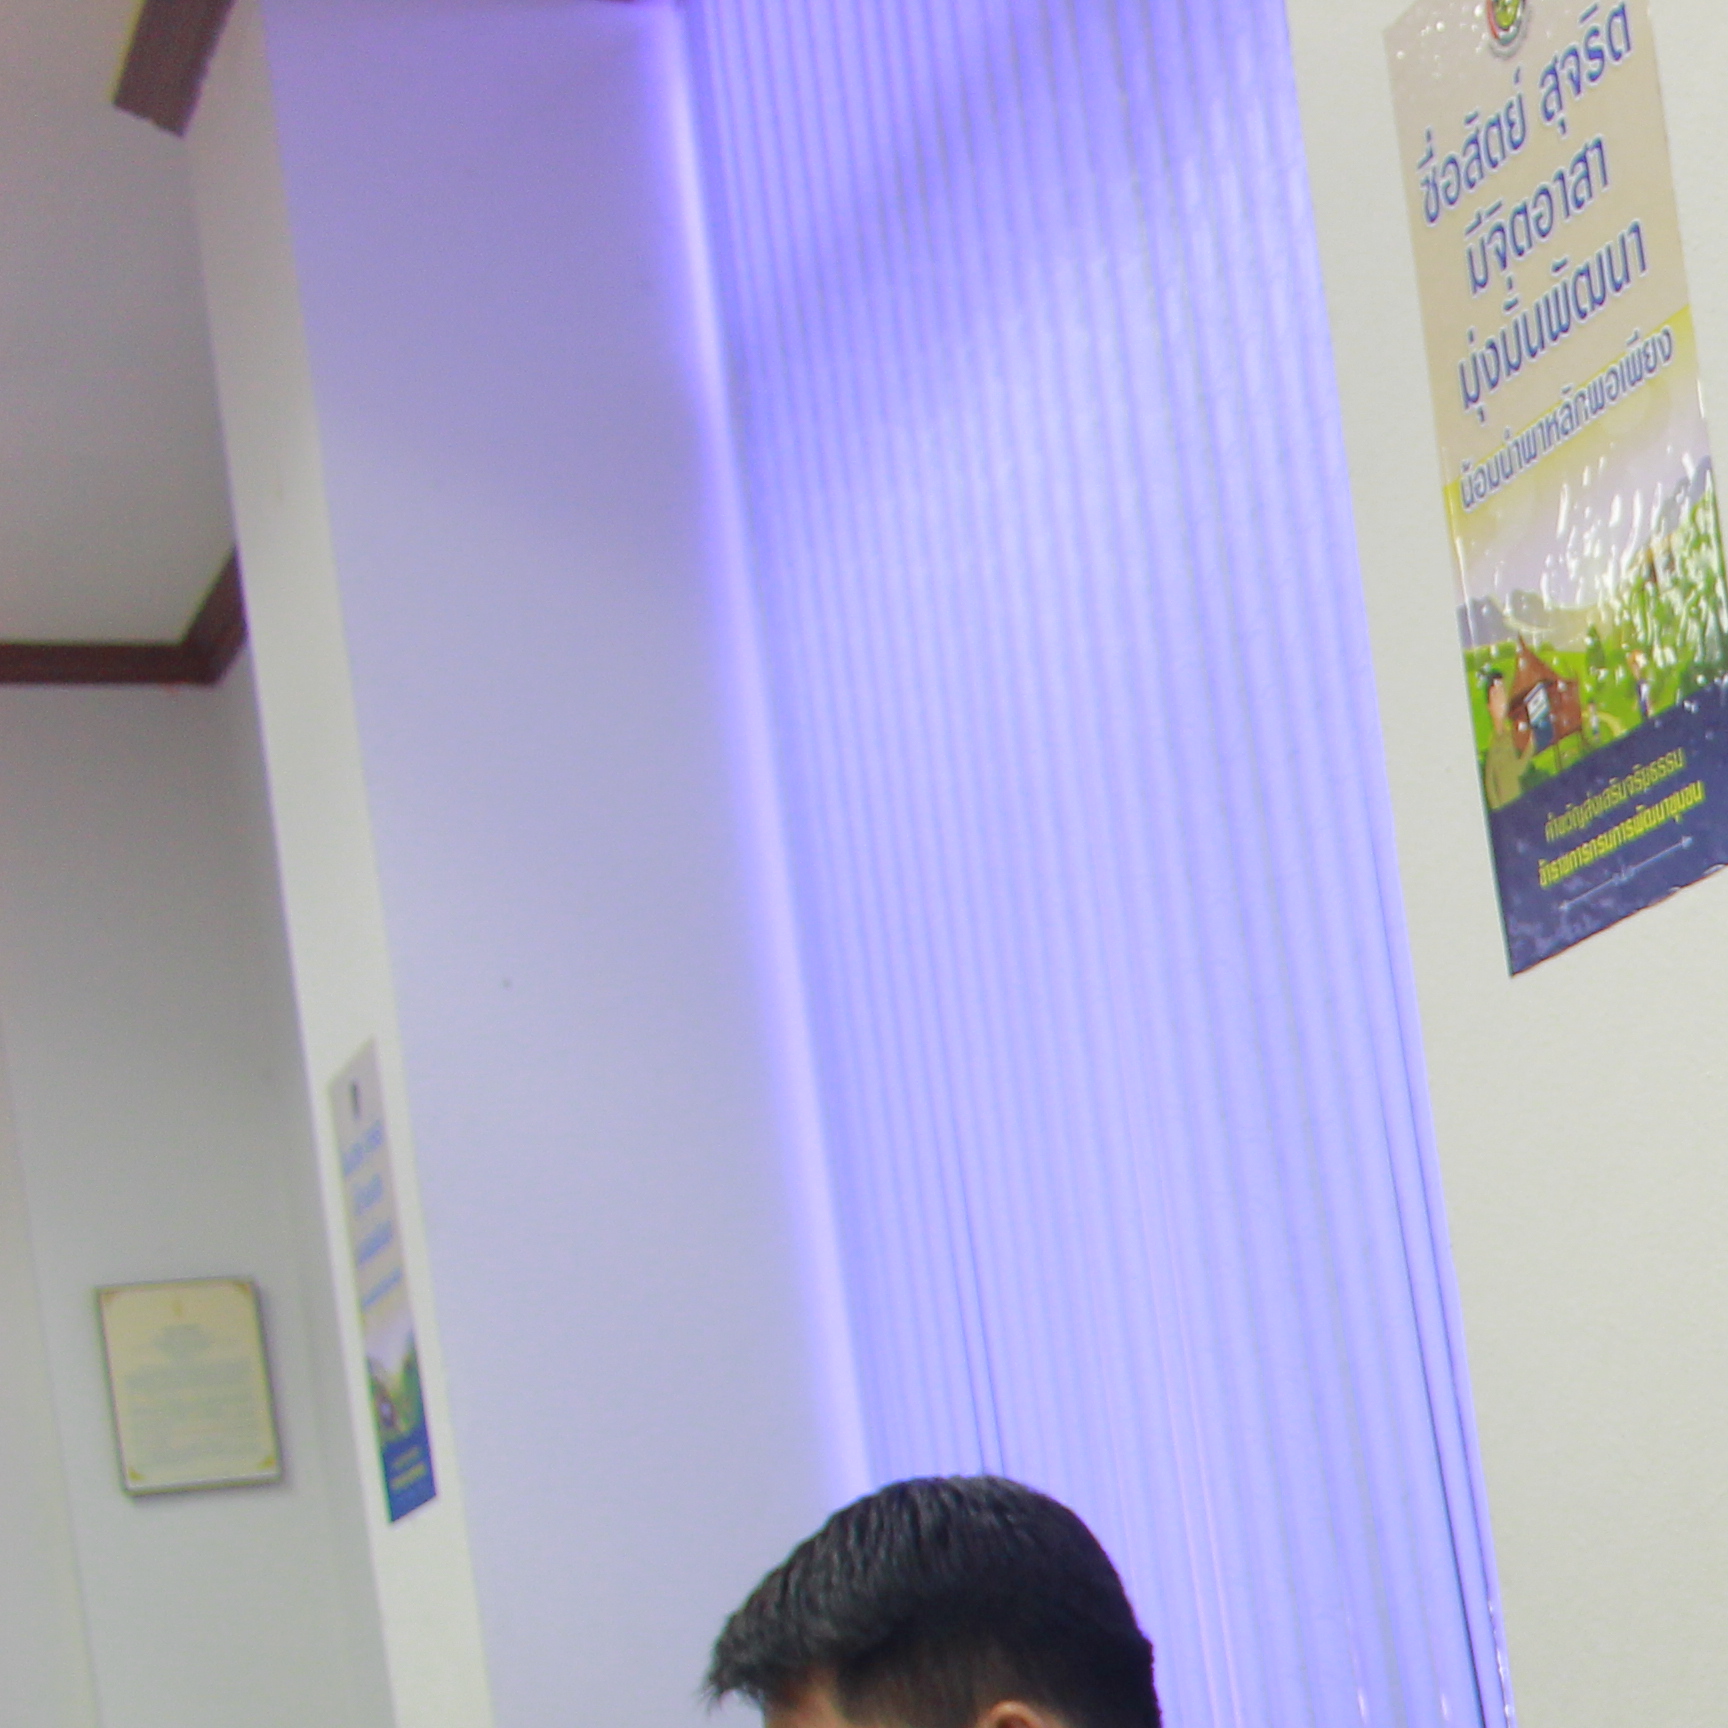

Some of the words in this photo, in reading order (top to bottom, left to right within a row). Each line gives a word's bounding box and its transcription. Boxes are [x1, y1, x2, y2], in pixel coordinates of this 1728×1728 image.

[1417, 67, 1528, 226] ซื่อสัตย์
[1539, 2, 1632, 134] สุจริต
[1464, 135, 1609, 295] มีจิตอาสา
[1458, 220, 1647, 422] มุ่งมั่นพัฒนา
[1460, 327, 1673, 509] น้อมนำพาหลักพอเพียง
